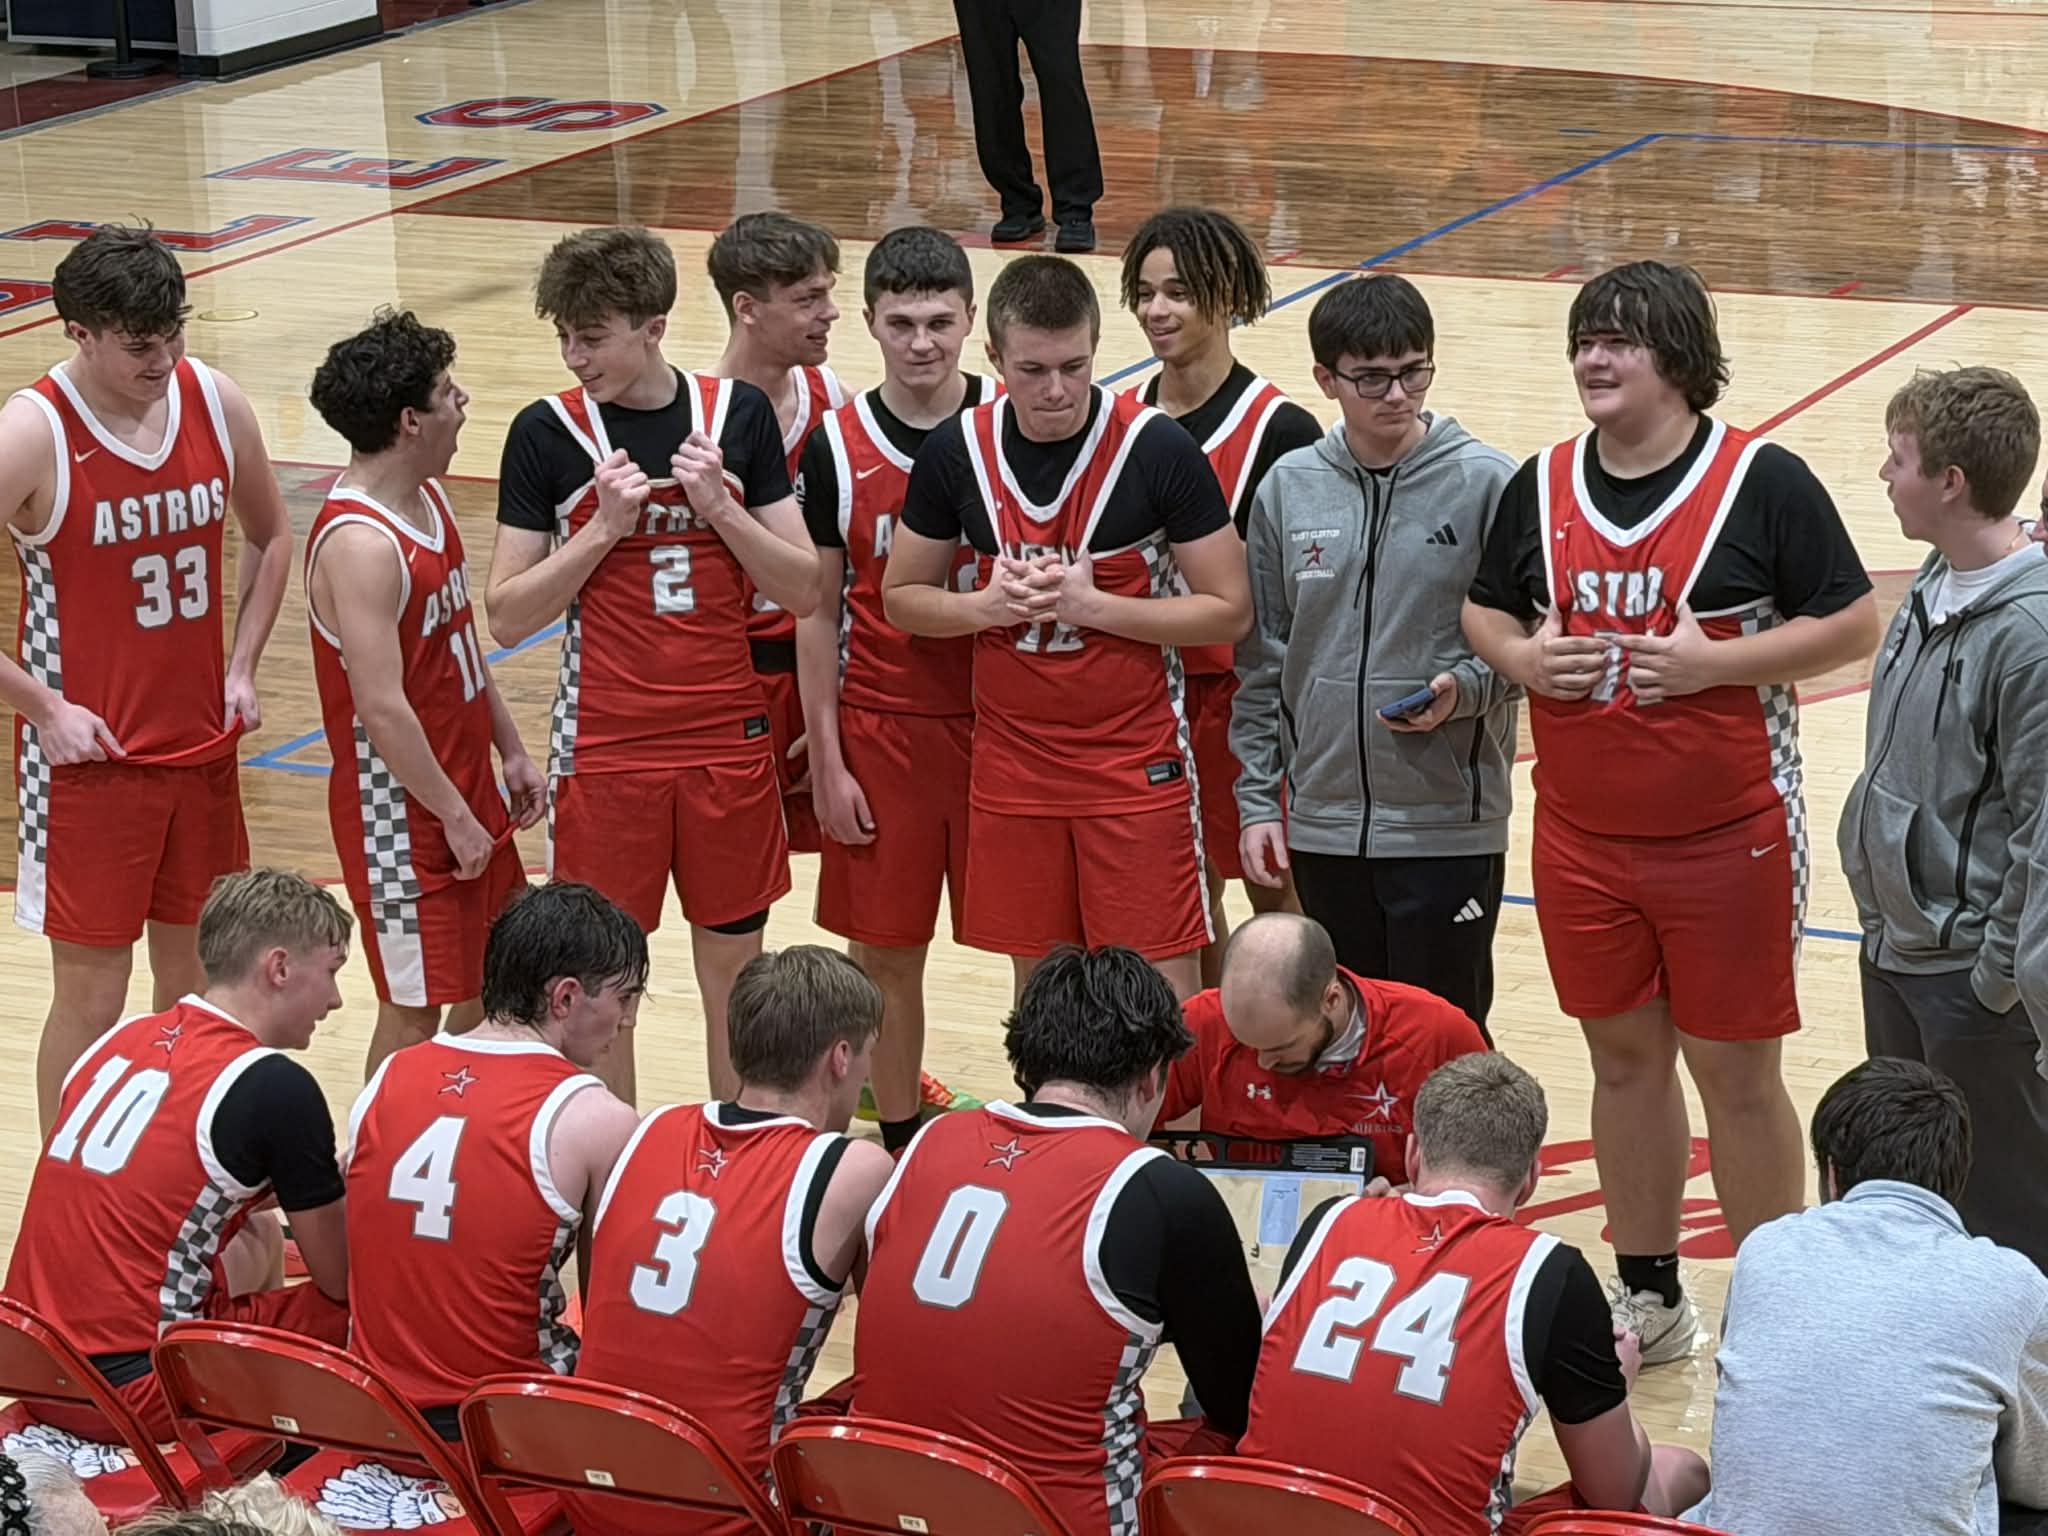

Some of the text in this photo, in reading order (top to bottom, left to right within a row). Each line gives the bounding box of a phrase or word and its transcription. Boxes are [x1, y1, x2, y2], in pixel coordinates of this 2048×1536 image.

[92, 476, 225, 547] ASTROS
[131, 544, 209, 629] 33
[648, 543, 695, 615] 2
[48, 1054, 172, 1175] 10
[388, 1114, 468, 1242] 4
[629, 1189, 718, 1317] 3
[911, 1183, 1009, 1310] 0
[1292, 1255, 1471, 1405] 24
